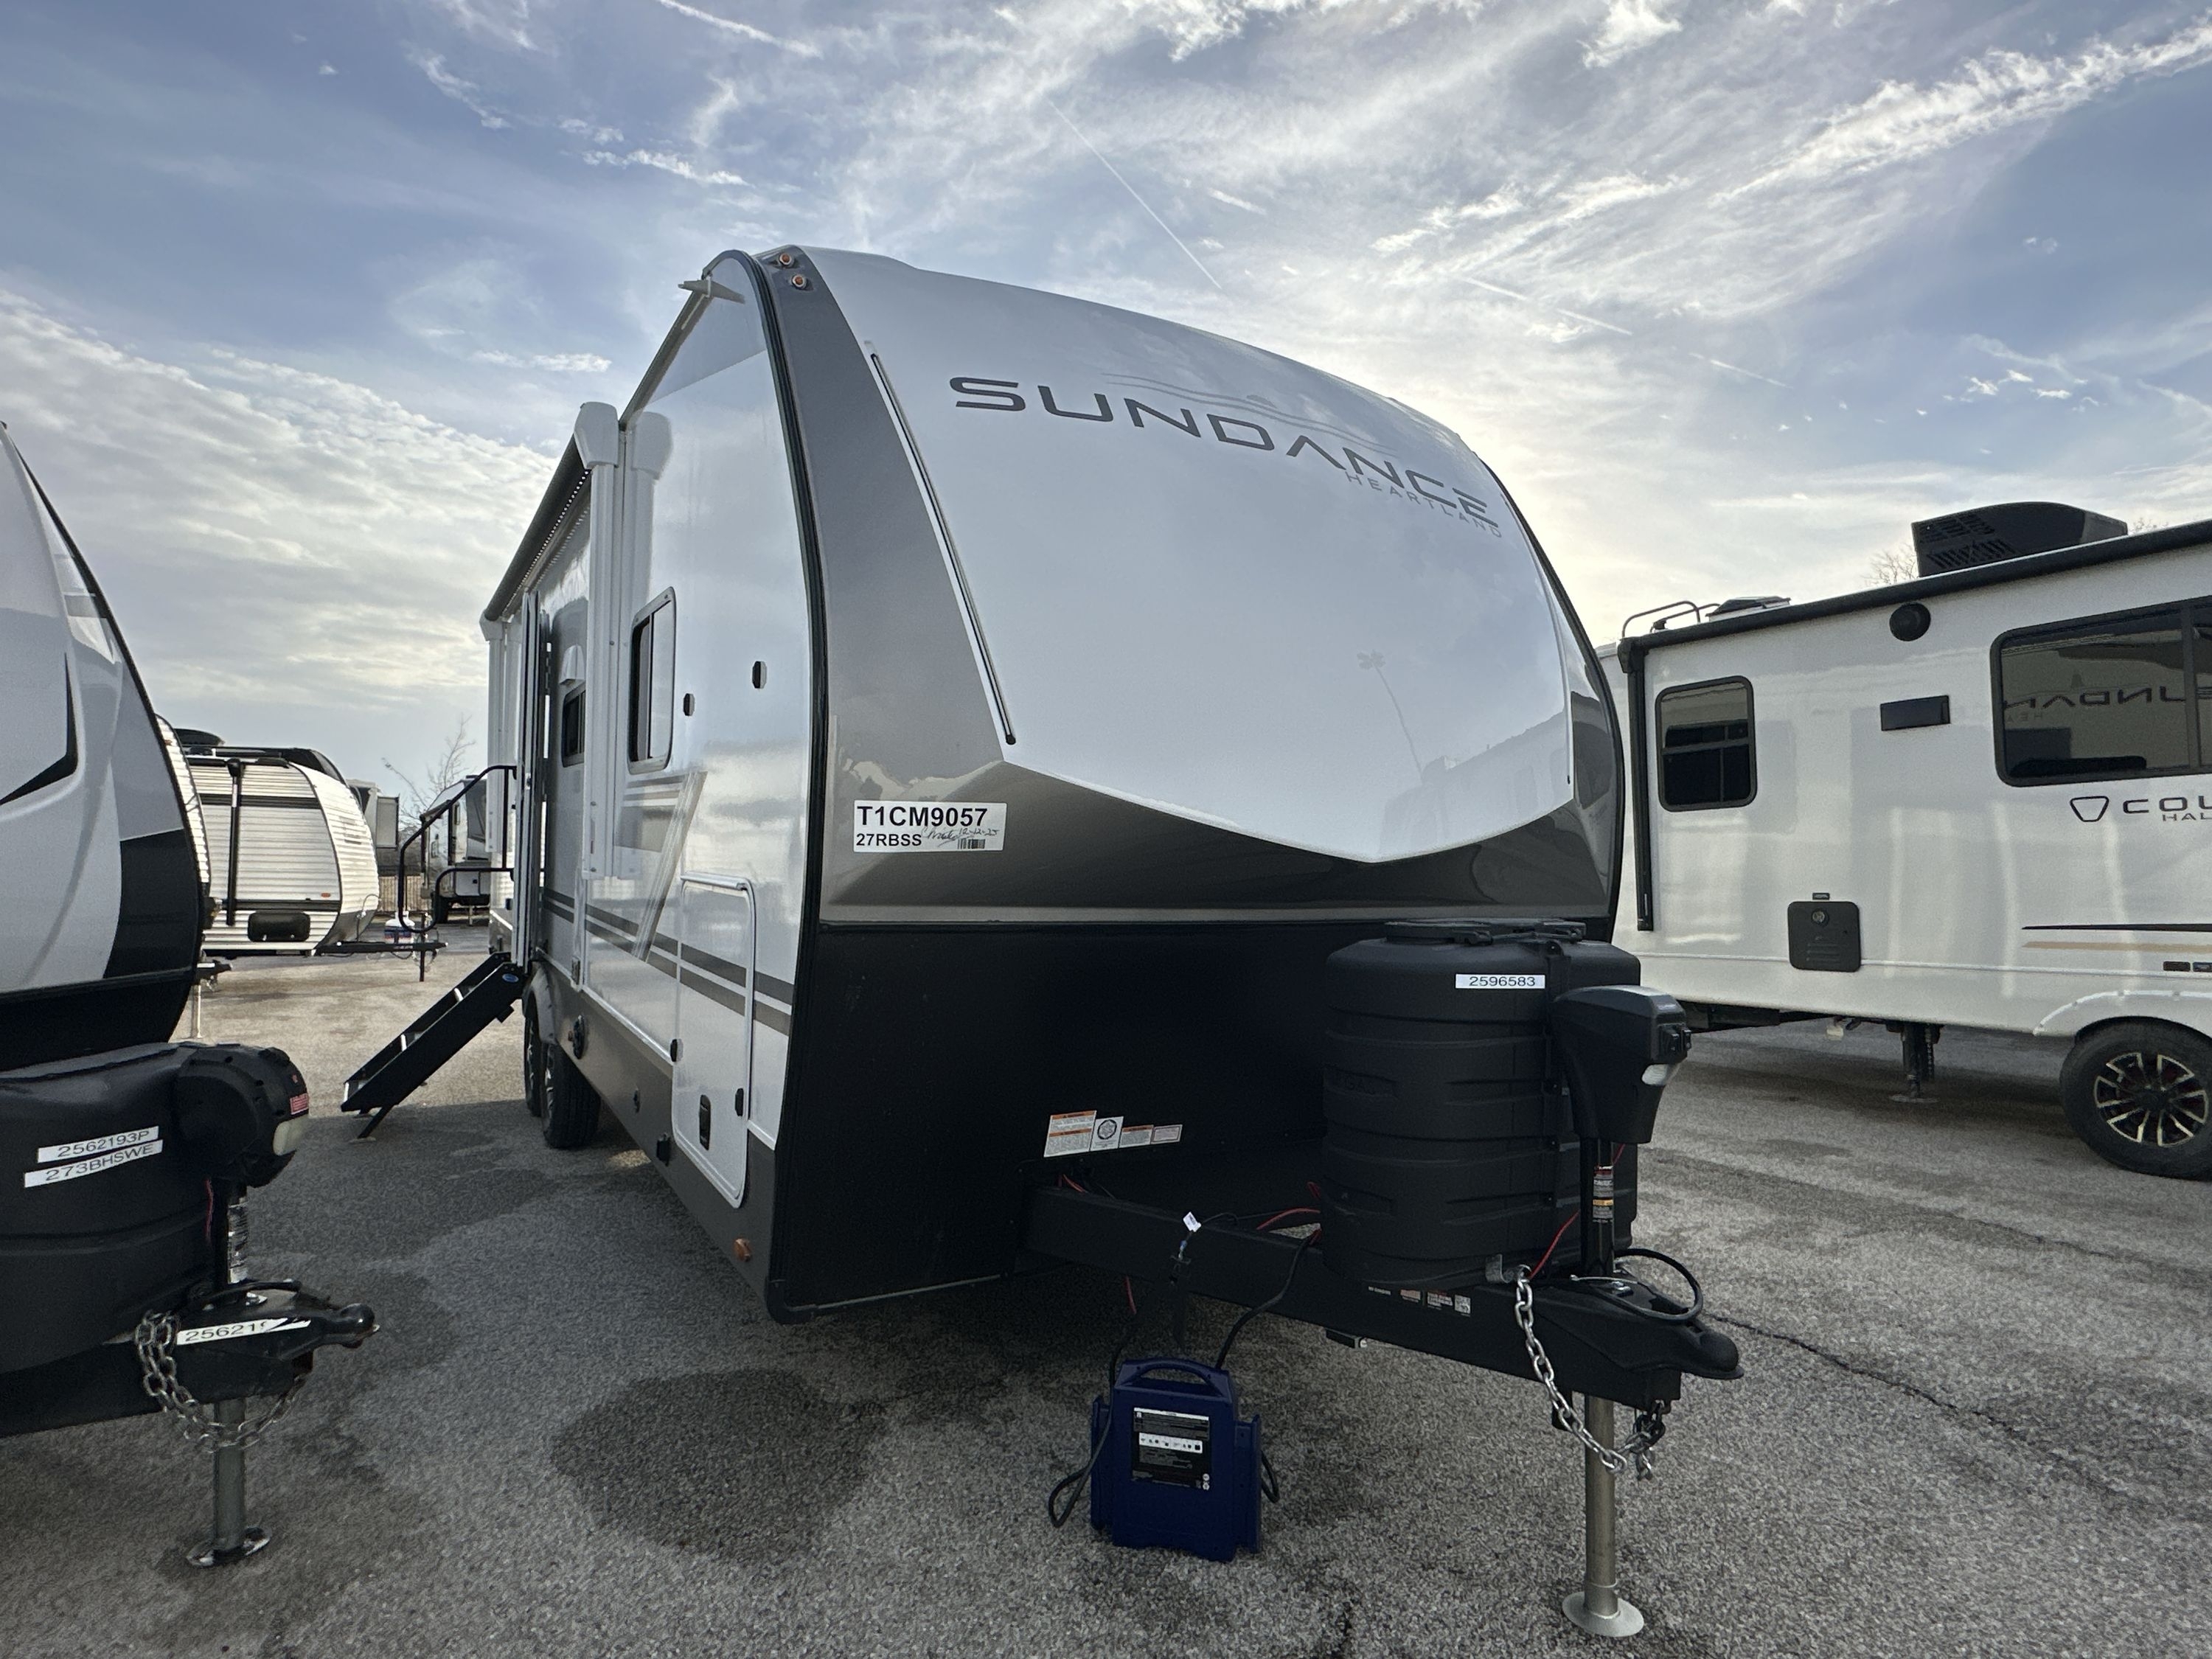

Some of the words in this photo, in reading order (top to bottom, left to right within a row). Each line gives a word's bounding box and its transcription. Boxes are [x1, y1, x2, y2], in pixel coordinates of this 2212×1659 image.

[949, 376, 1499, 528] SUNDANCE
[1345, 471, 1503, 538] HEARTLAND
[857, 806, 988, 827] T1CM9057
[856, 833, 922, 846] 27RBSS
[1469, 976, 1536, 987] 2596583
[58, 1130, 150, 1158] 2562193P
[46, 1144, 155, 1181] 273BHSWE
